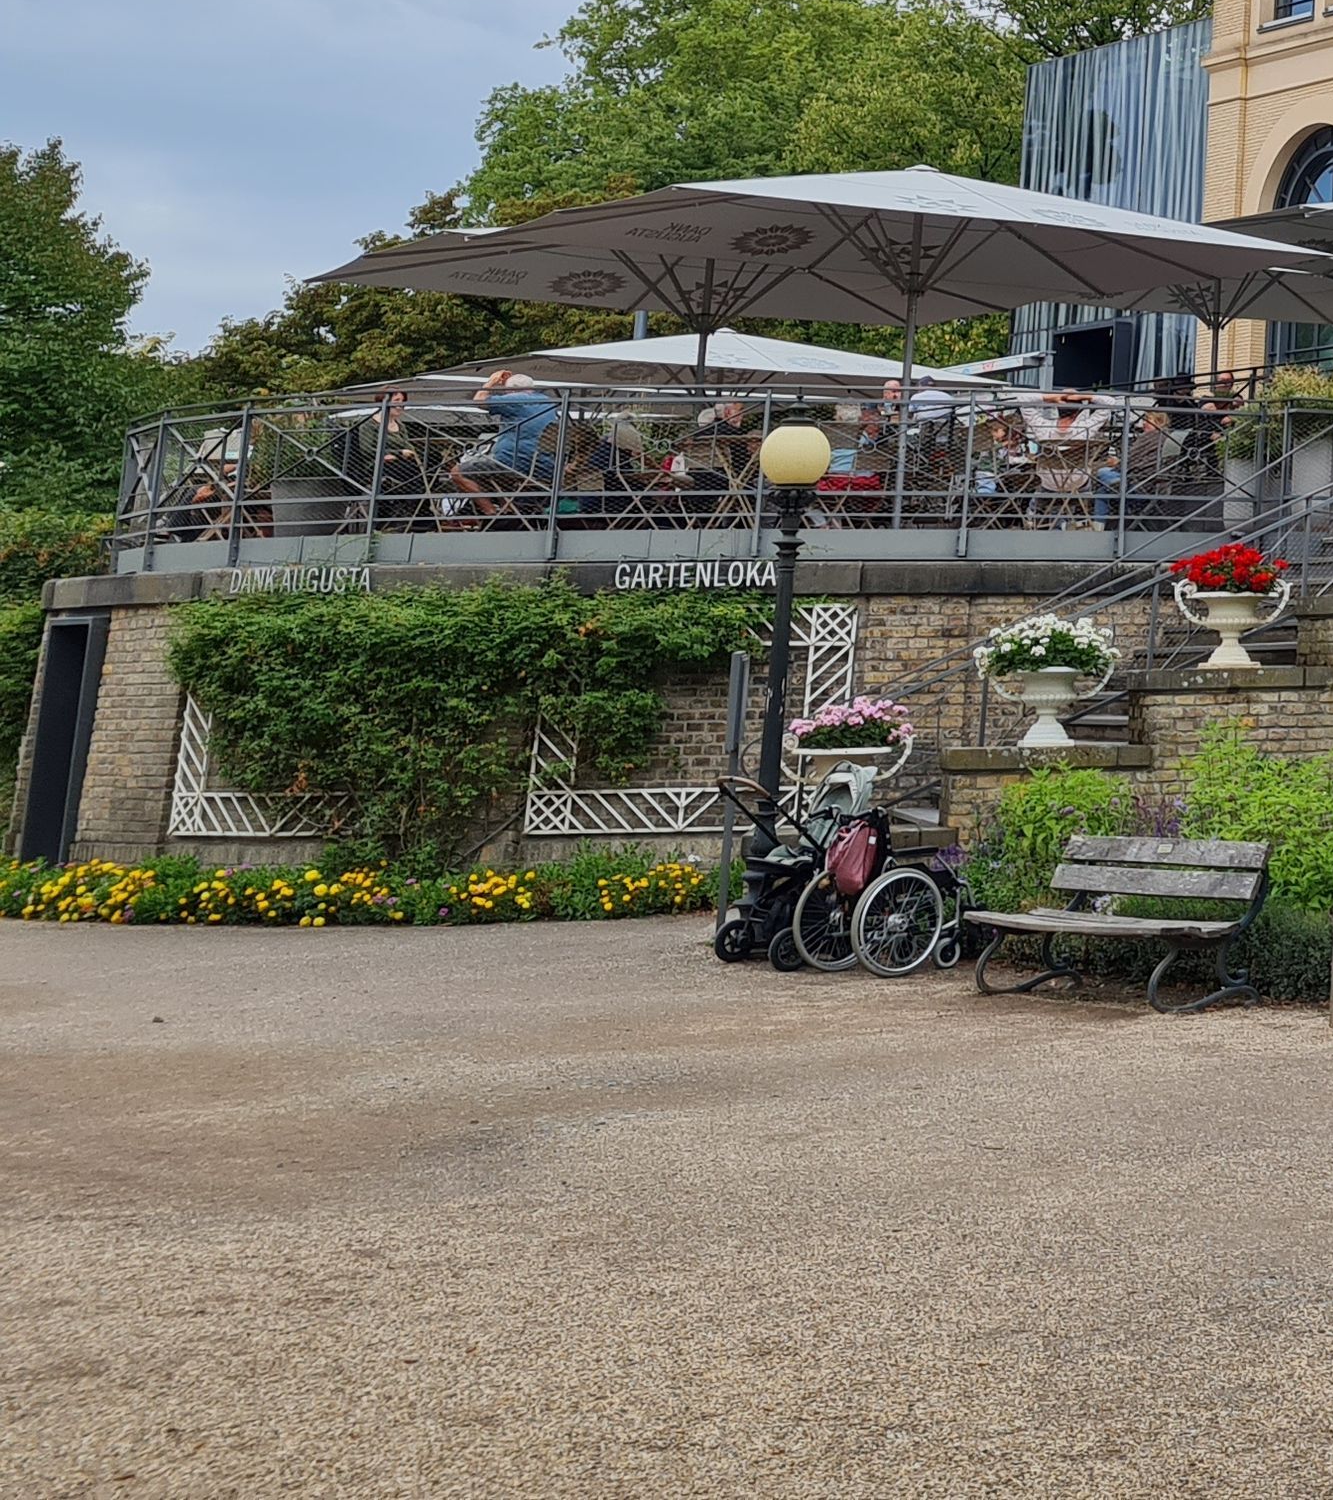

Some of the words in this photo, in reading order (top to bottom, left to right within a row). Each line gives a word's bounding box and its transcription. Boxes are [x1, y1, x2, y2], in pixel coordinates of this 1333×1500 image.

[229, 568, 275, 594] DANK
[279, 566, 370, 594] AUGUSTA
[614, 560, 776, 589] GARTENLOKA
